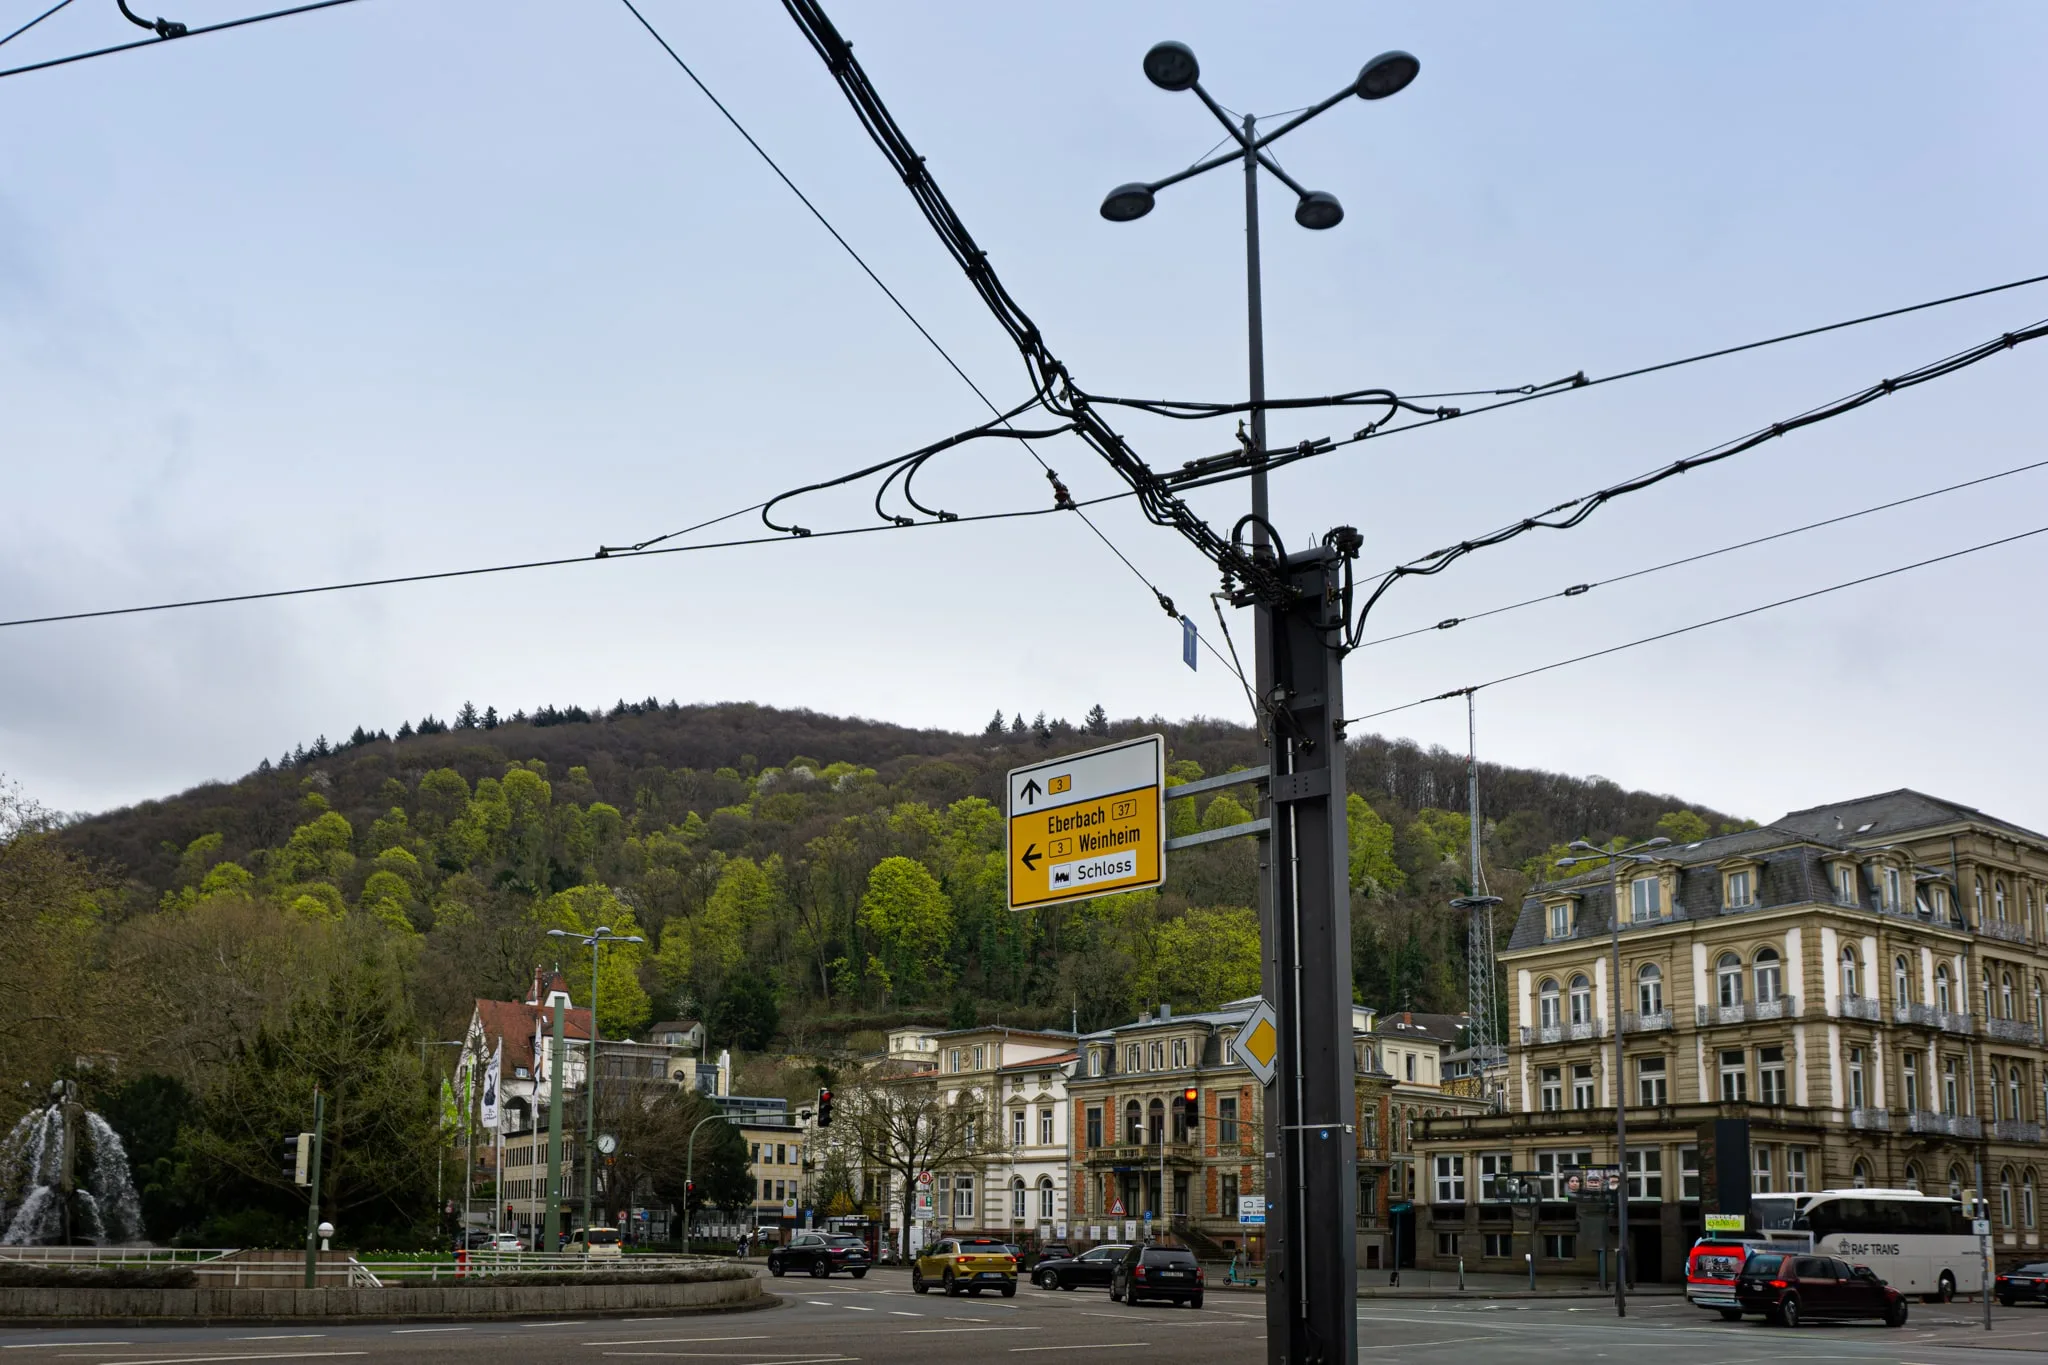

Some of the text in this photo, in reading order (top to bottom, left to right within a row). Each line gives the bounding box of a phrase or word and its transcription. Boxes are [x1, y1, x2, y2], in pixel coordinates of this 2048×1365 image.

[1056, 778, 1063, 791] 3
[1048, 803, 1131, 834] Eberbach 37
[1057, 826, 1141, 854] 3 Weinheim
[1078, 859, 1132, 881] Schloss
[1851, 1243, 1900, 1255] RAF TRANS
